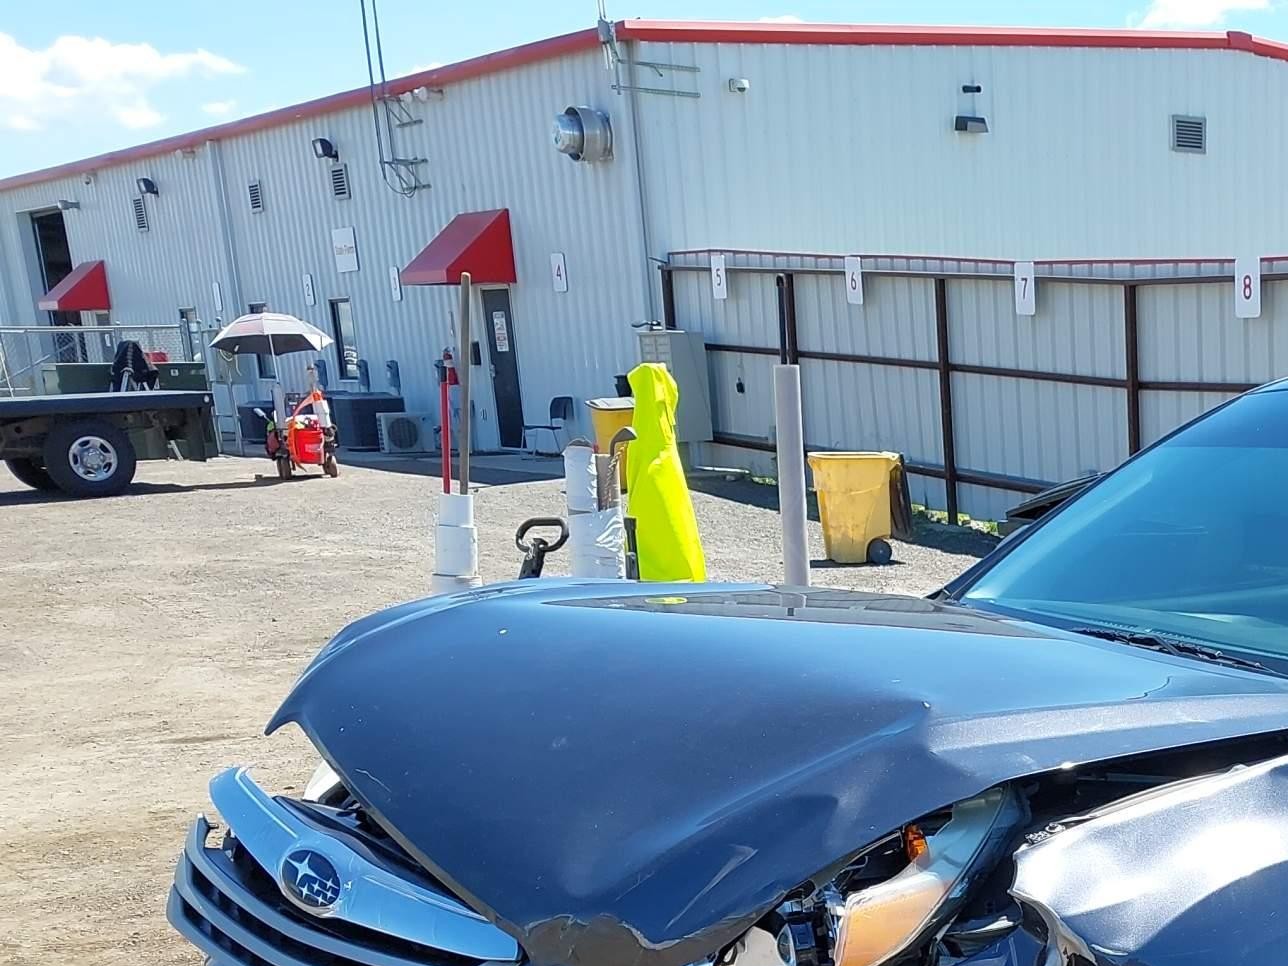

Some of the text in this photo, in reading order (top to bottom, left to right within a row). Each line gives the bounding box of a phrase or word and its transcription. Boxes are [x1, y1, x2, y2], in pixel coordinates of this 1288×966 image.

[556, 263, 562, 281] 4
[715, 268, 722, 287] 5
[850, 271, 857, 290] 6
[1021, 277, 1028, 300] 7
[1243, 274, 1252, 300] 8
